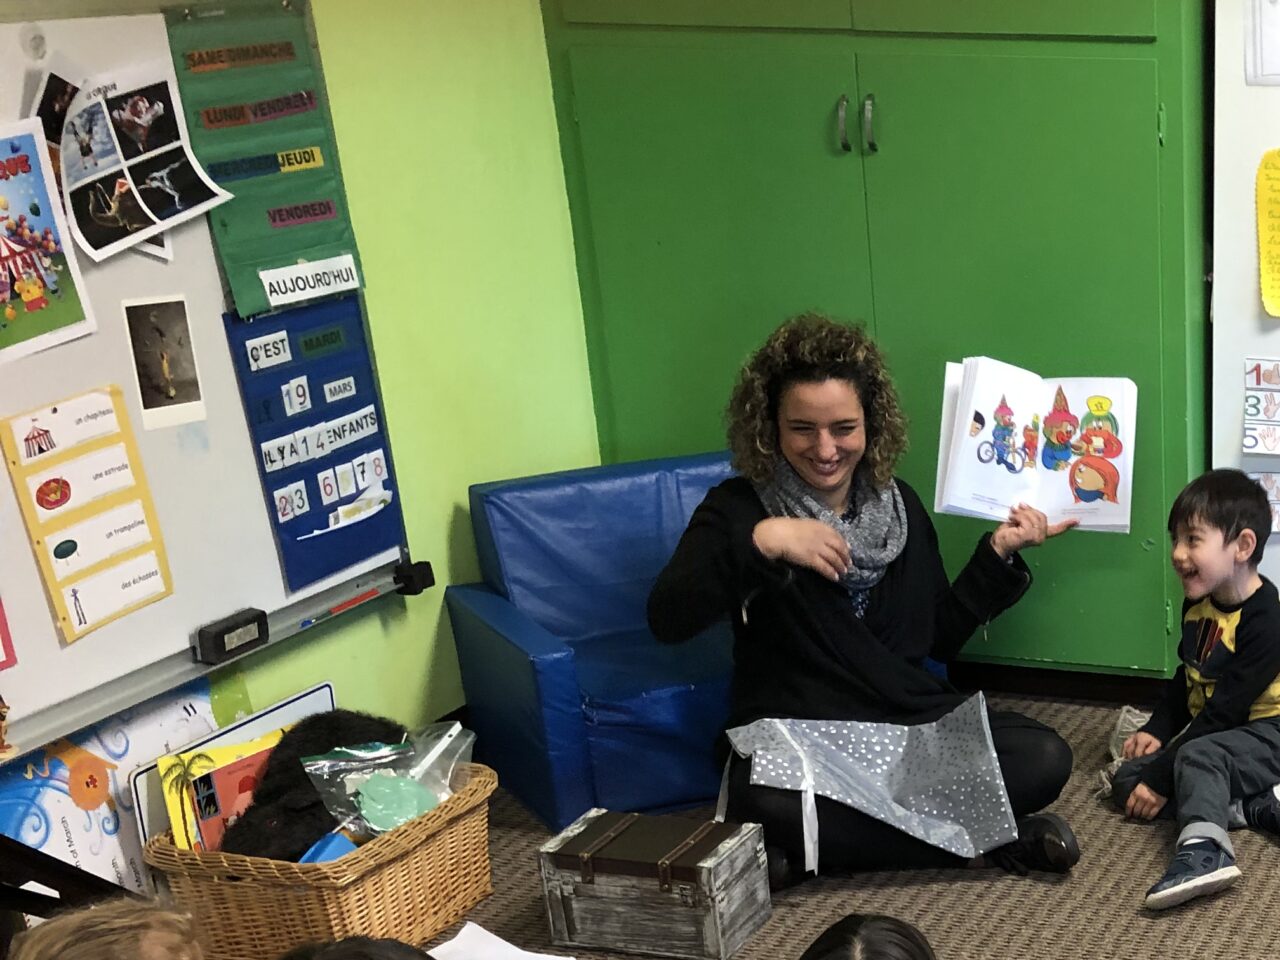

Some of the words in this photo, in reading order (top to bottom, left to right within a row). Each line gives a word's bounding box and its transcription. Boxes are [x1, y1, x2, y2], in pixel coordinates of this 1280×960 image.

[206, 104, 246, 124] LUNDI
[279, 149, 316, 168] JEUDI
[267, 201, 333, 223] VENDREDI
[268, 266, 355, 297] AUJOURD'HUI
[250, 338, 286, 364] C'EST
[303, 329, 342, 352] MARDI
[1246, 363, 1261, 386] 1
[284, 384, 307, 410] 19
[328, 380, 354, 399] MARS
[1245, 395, 1261, 417] 3
[326, 411, 377, 445] ENFANTS
[1243, 427, 1259, 449] 5
[60, 816, 75, 848] March
